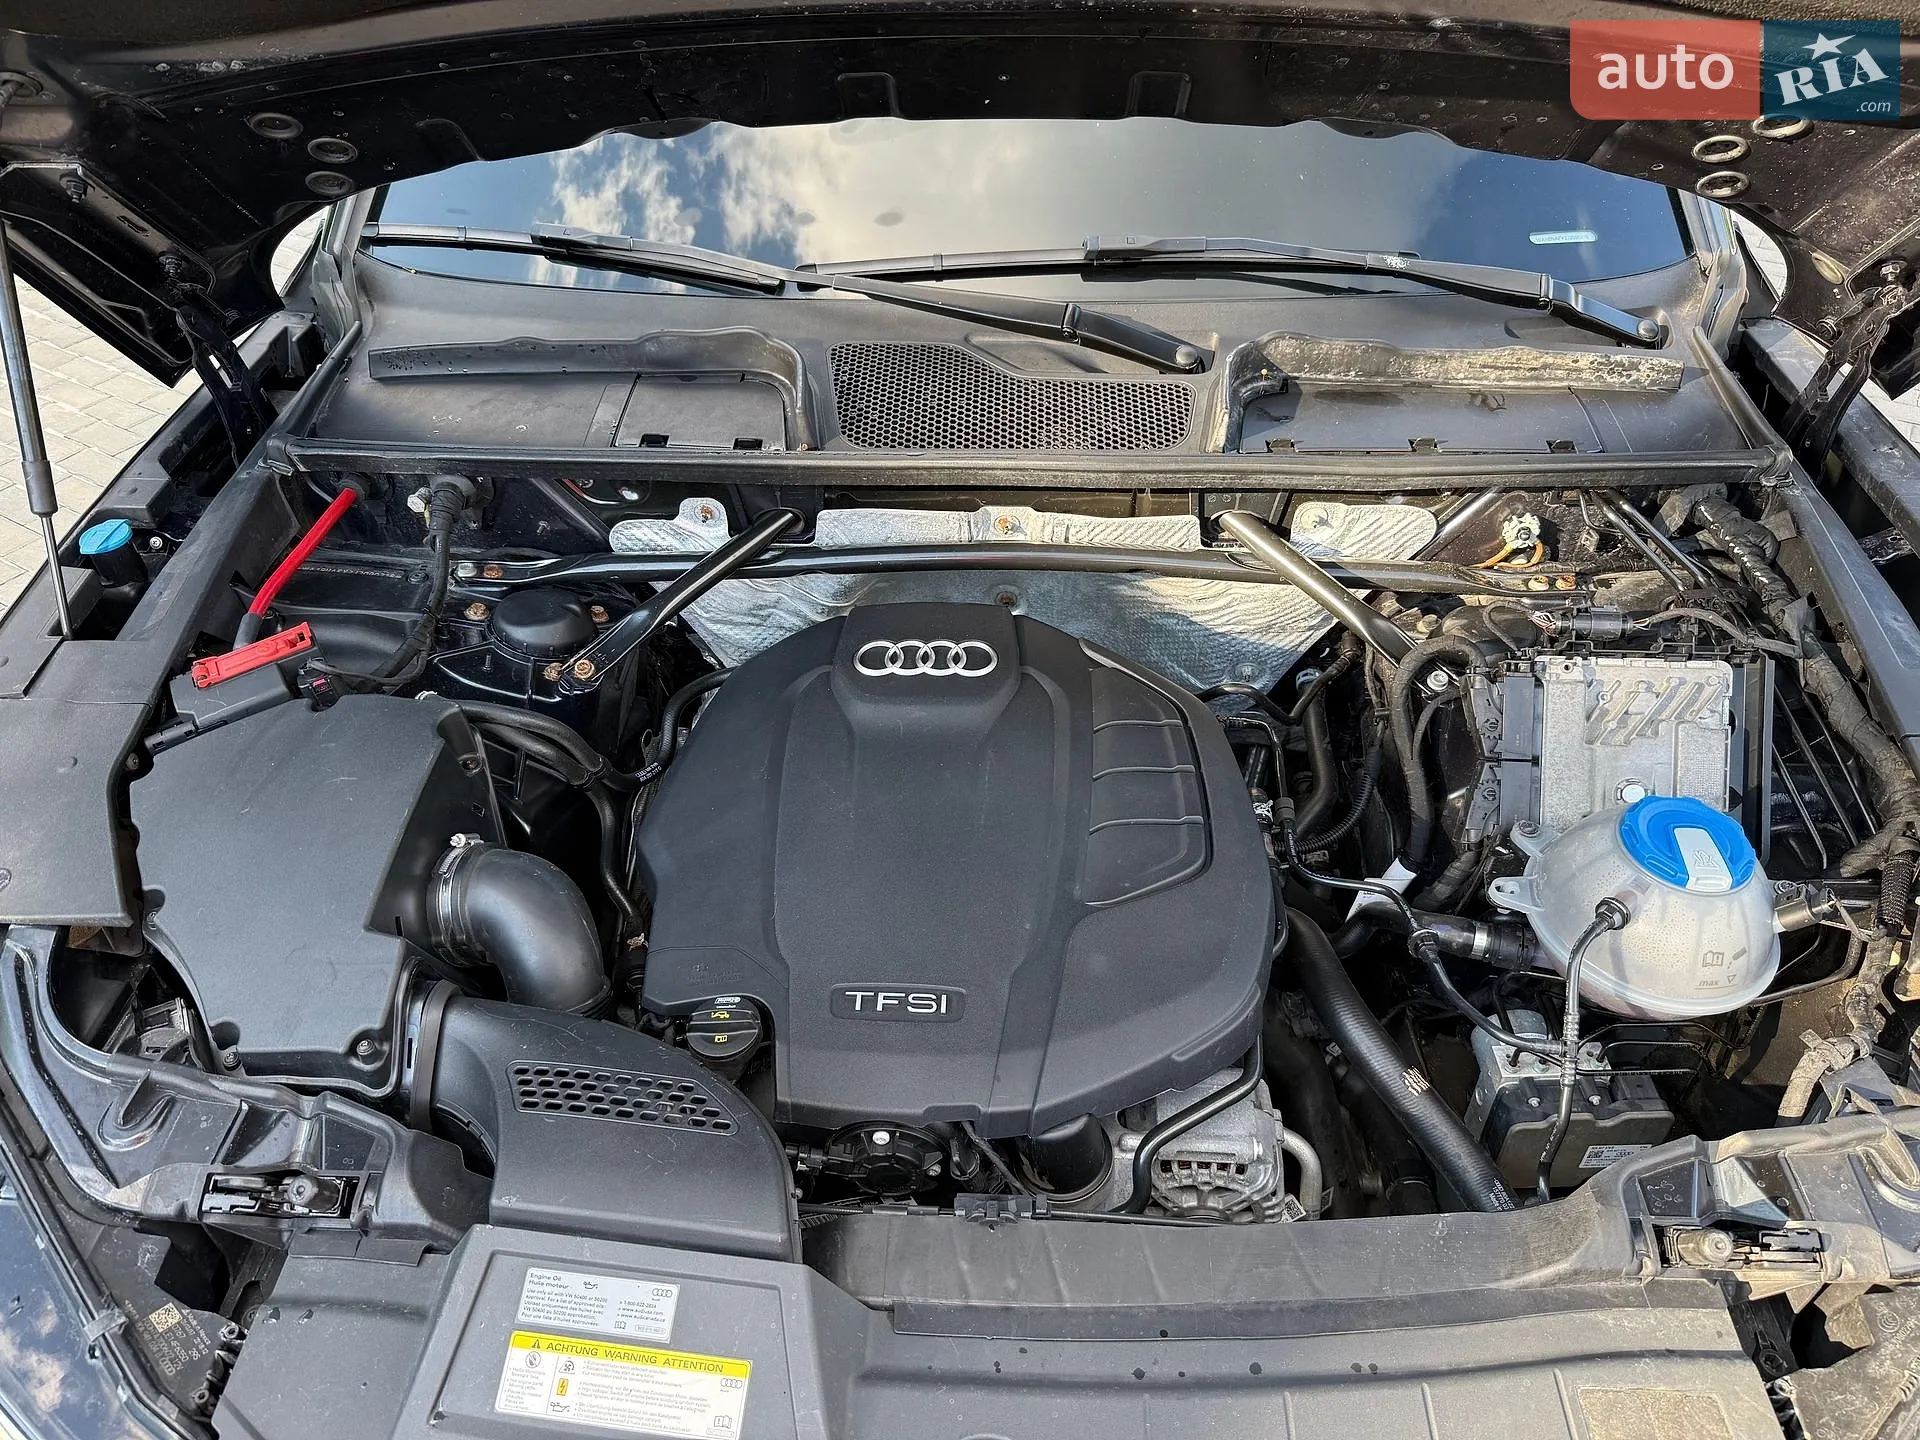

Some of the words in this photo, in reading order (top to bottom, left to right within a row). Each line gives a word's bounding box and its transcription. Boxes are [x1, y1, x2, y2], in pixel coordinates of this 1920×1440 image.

[845, 991, 947, 1014] TFSI
[530, 1272, 552, 1281] Engine
[546, 1342, 599, 1356] ACHTUNG
[604, 1349, 657, 1364] WARNING
[663, 1358, 724, 1373] ATTENTION
